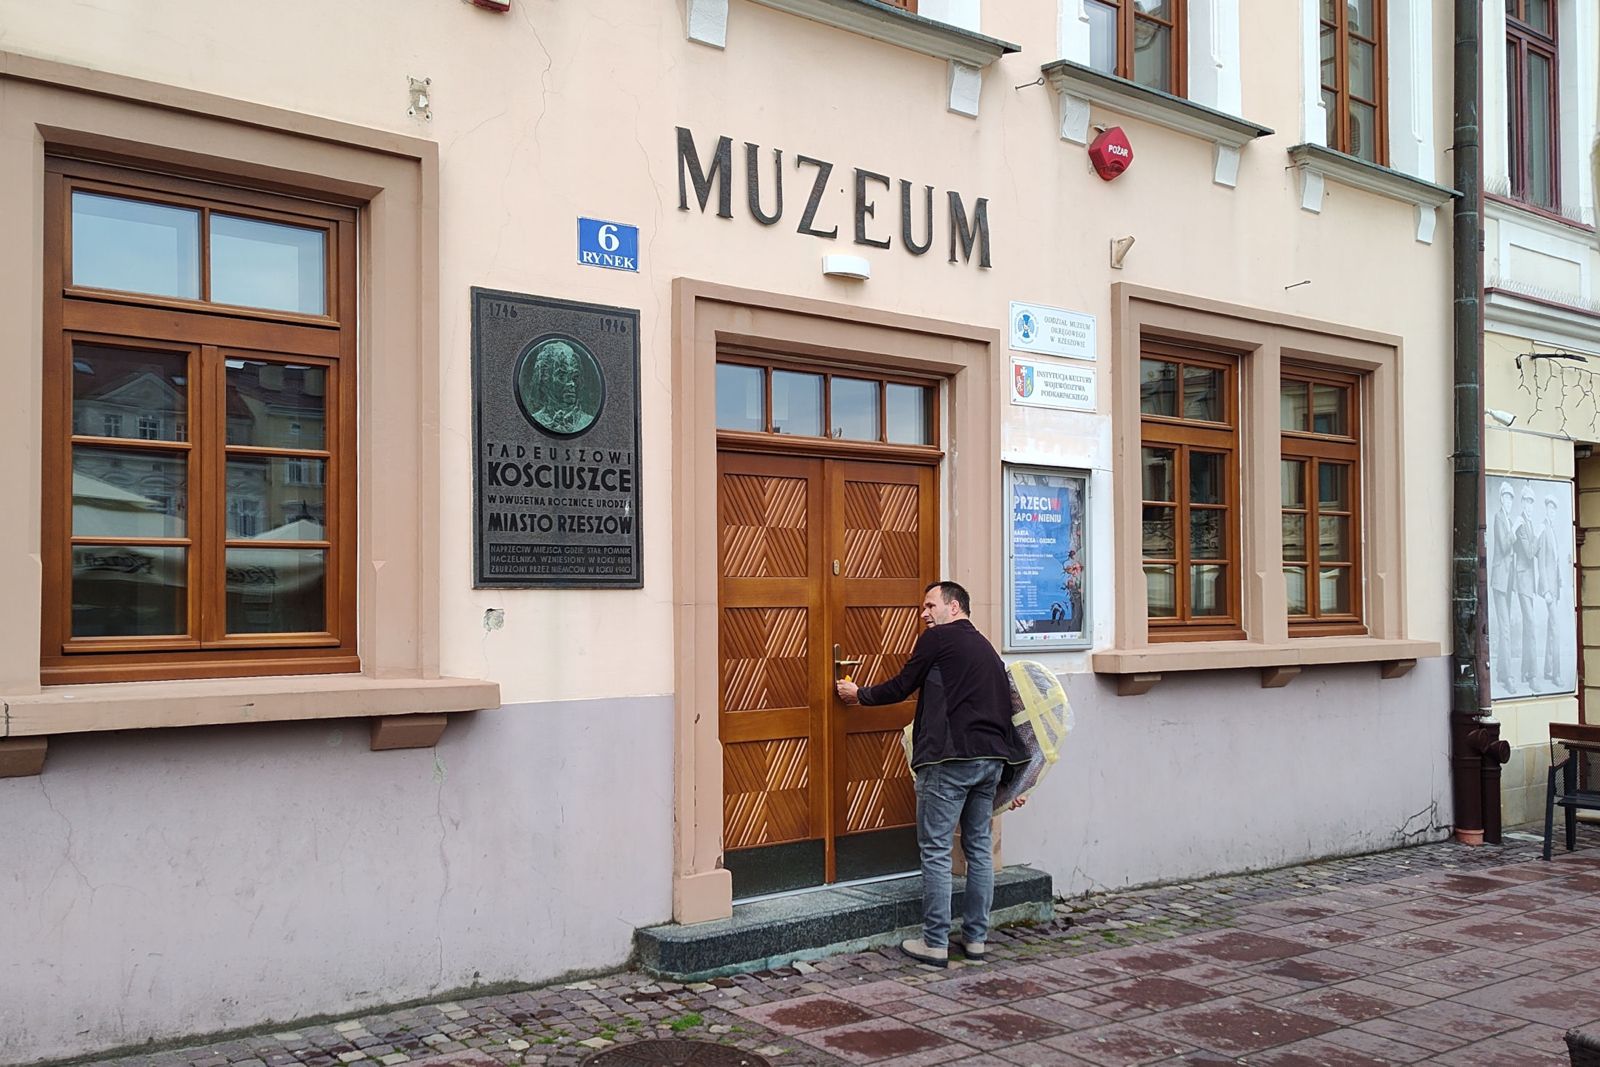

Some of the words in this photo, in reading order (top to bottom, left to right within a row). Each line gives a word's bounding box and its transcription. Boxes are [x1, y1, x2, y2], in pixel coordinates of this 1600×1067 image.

[1108, 144, 1128, 158] POŻAR
[675, 126, 993, 268] MUZEUM
[598, 224, 620, 252] 6
[582, 250, 635, 269] RYNEK
[489, 302, 518, 318] 1746
[600, 317, 627, 333] 1946
[1044, 316, 1068, 326] ODDZIAŁ
[1070, 320, 1091, 330] MUZEUM
[1058, 337, 1086, 348] RZESZOWIE
[1036, 370, 1068, 381] INSTYTUCJA
[1068, 374, 1092, 384] KULTURY
[1044, 380, 1086, 392] WOJEWÓDZTWA
[1041, 390, 1088, 402] PODKARPACKIEGO
[487, 443, 631, 465] TADEUSZOWI
[487, 461, 631, 493] KOŚCIUSZCE
[488, 494, 497, 504] W
[488, 512, 553, 533] MIASTO
[557, 515, 633, 535] RZESZÓW
[490, 545, 531, 554] NAPRZECIW
[532, 546, 562, 555] MIEJSCA
[564, 546, 584, 555] GDZIE
[603, 547, 631, 555] POMNIK
[490, 555, 536, 564] NACZELNIKA
[541, 556, 585, 565] WZNIESIONY
[588, 557, 597, 565] W
[597, 557, 615, 565] ROKU
[490, 565, 528, 574] ZBURZONY
[529, 566, 552, 574] PRZEZ
[588, 566, 595, 574] W
[596, 566, 614, 574] ROKU
